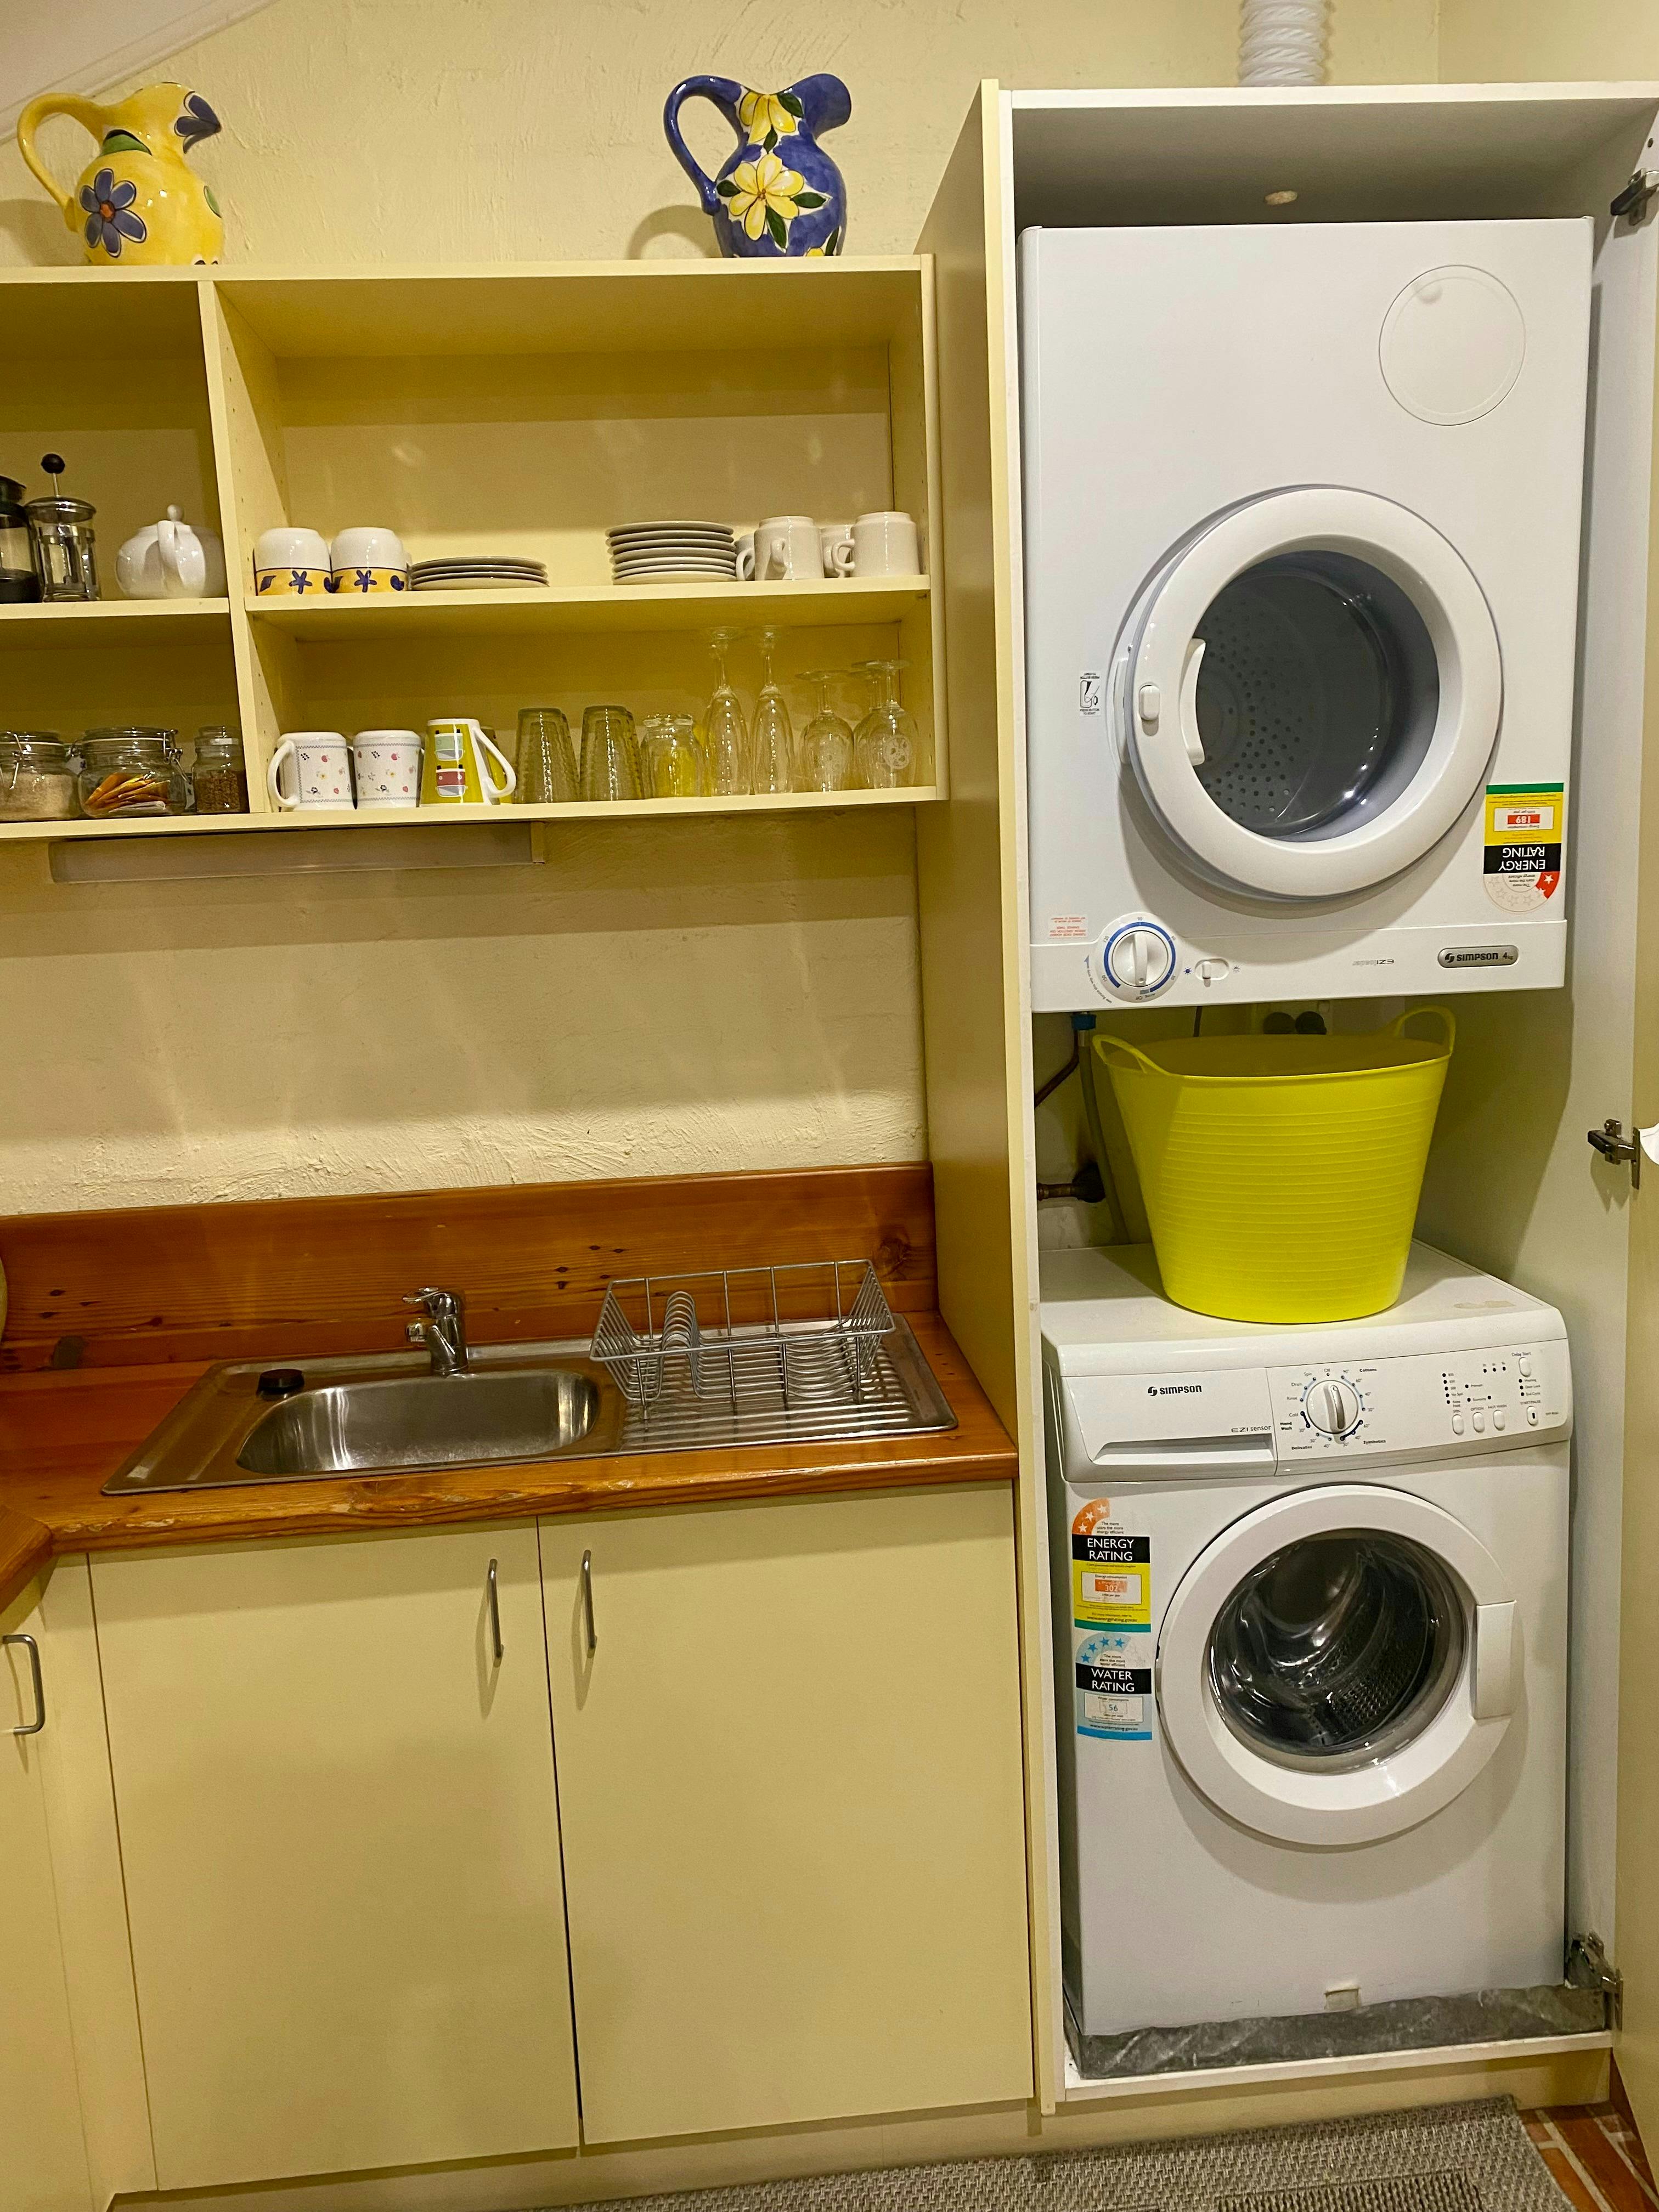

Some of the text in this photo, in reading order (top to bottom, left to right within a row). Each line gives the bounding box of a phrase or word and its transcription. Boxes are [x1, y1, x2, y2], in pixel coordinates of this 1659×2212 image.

[1516, 815, 1531, 824] 189
[1503, 847, 1545, 858] RATING
[1498, 859, 1546, 871] ENERGY
[1457, 952, 1498, 961] SIMPSON
[1159, 1385, 1202, 1395] SIMPSON
[1087, 1538, 1134, 1549] ENERGY
[1089, 1550, 1133, 1561] RATING
[1091, 1668, 1132, 1680] WATER
[1092, 1680, 1135, 1692] RATING
